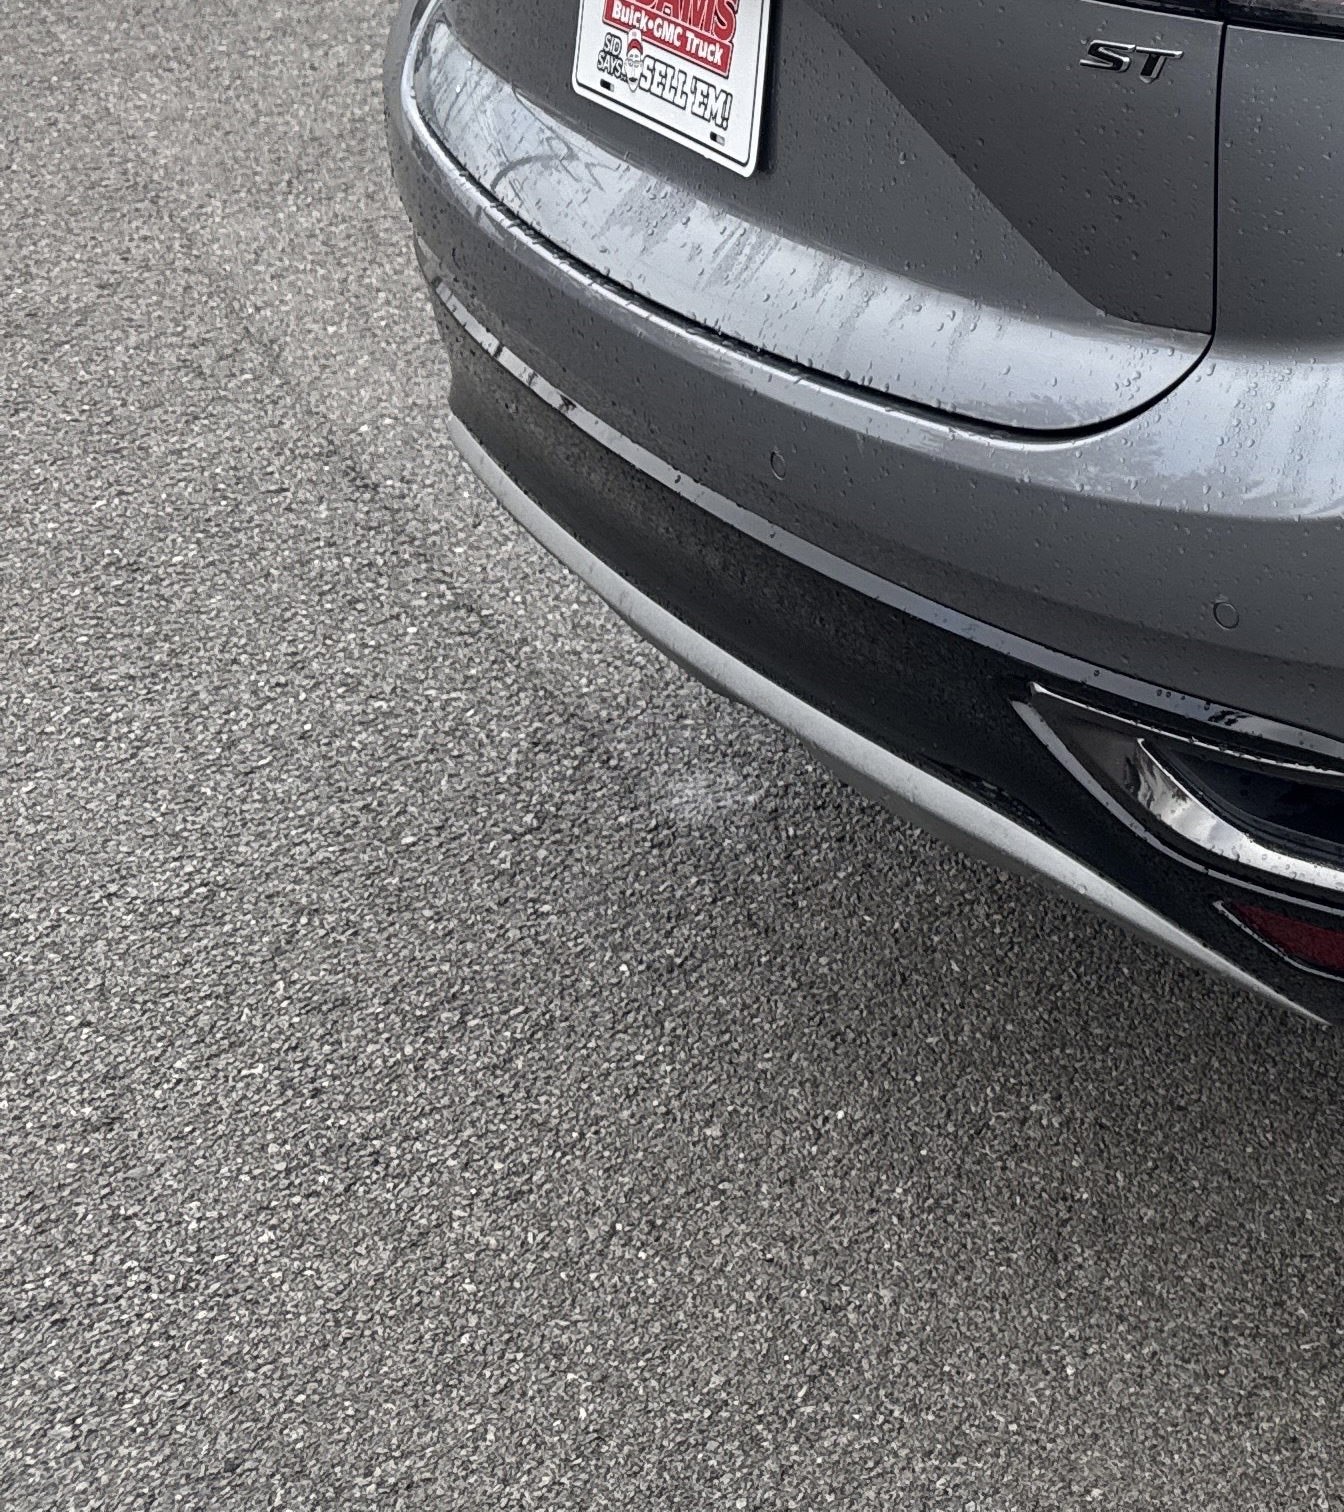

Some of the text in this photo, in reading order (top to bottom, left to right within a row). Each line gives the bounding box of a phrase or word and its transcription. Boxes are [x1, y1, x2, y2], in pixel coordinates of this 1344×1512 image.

[603, 32, 622, 58] SID
[685, 29, 724, 66] Truck
[1079, 39, 1185, 84] ST
[639, 55, 688, 110] SELL
